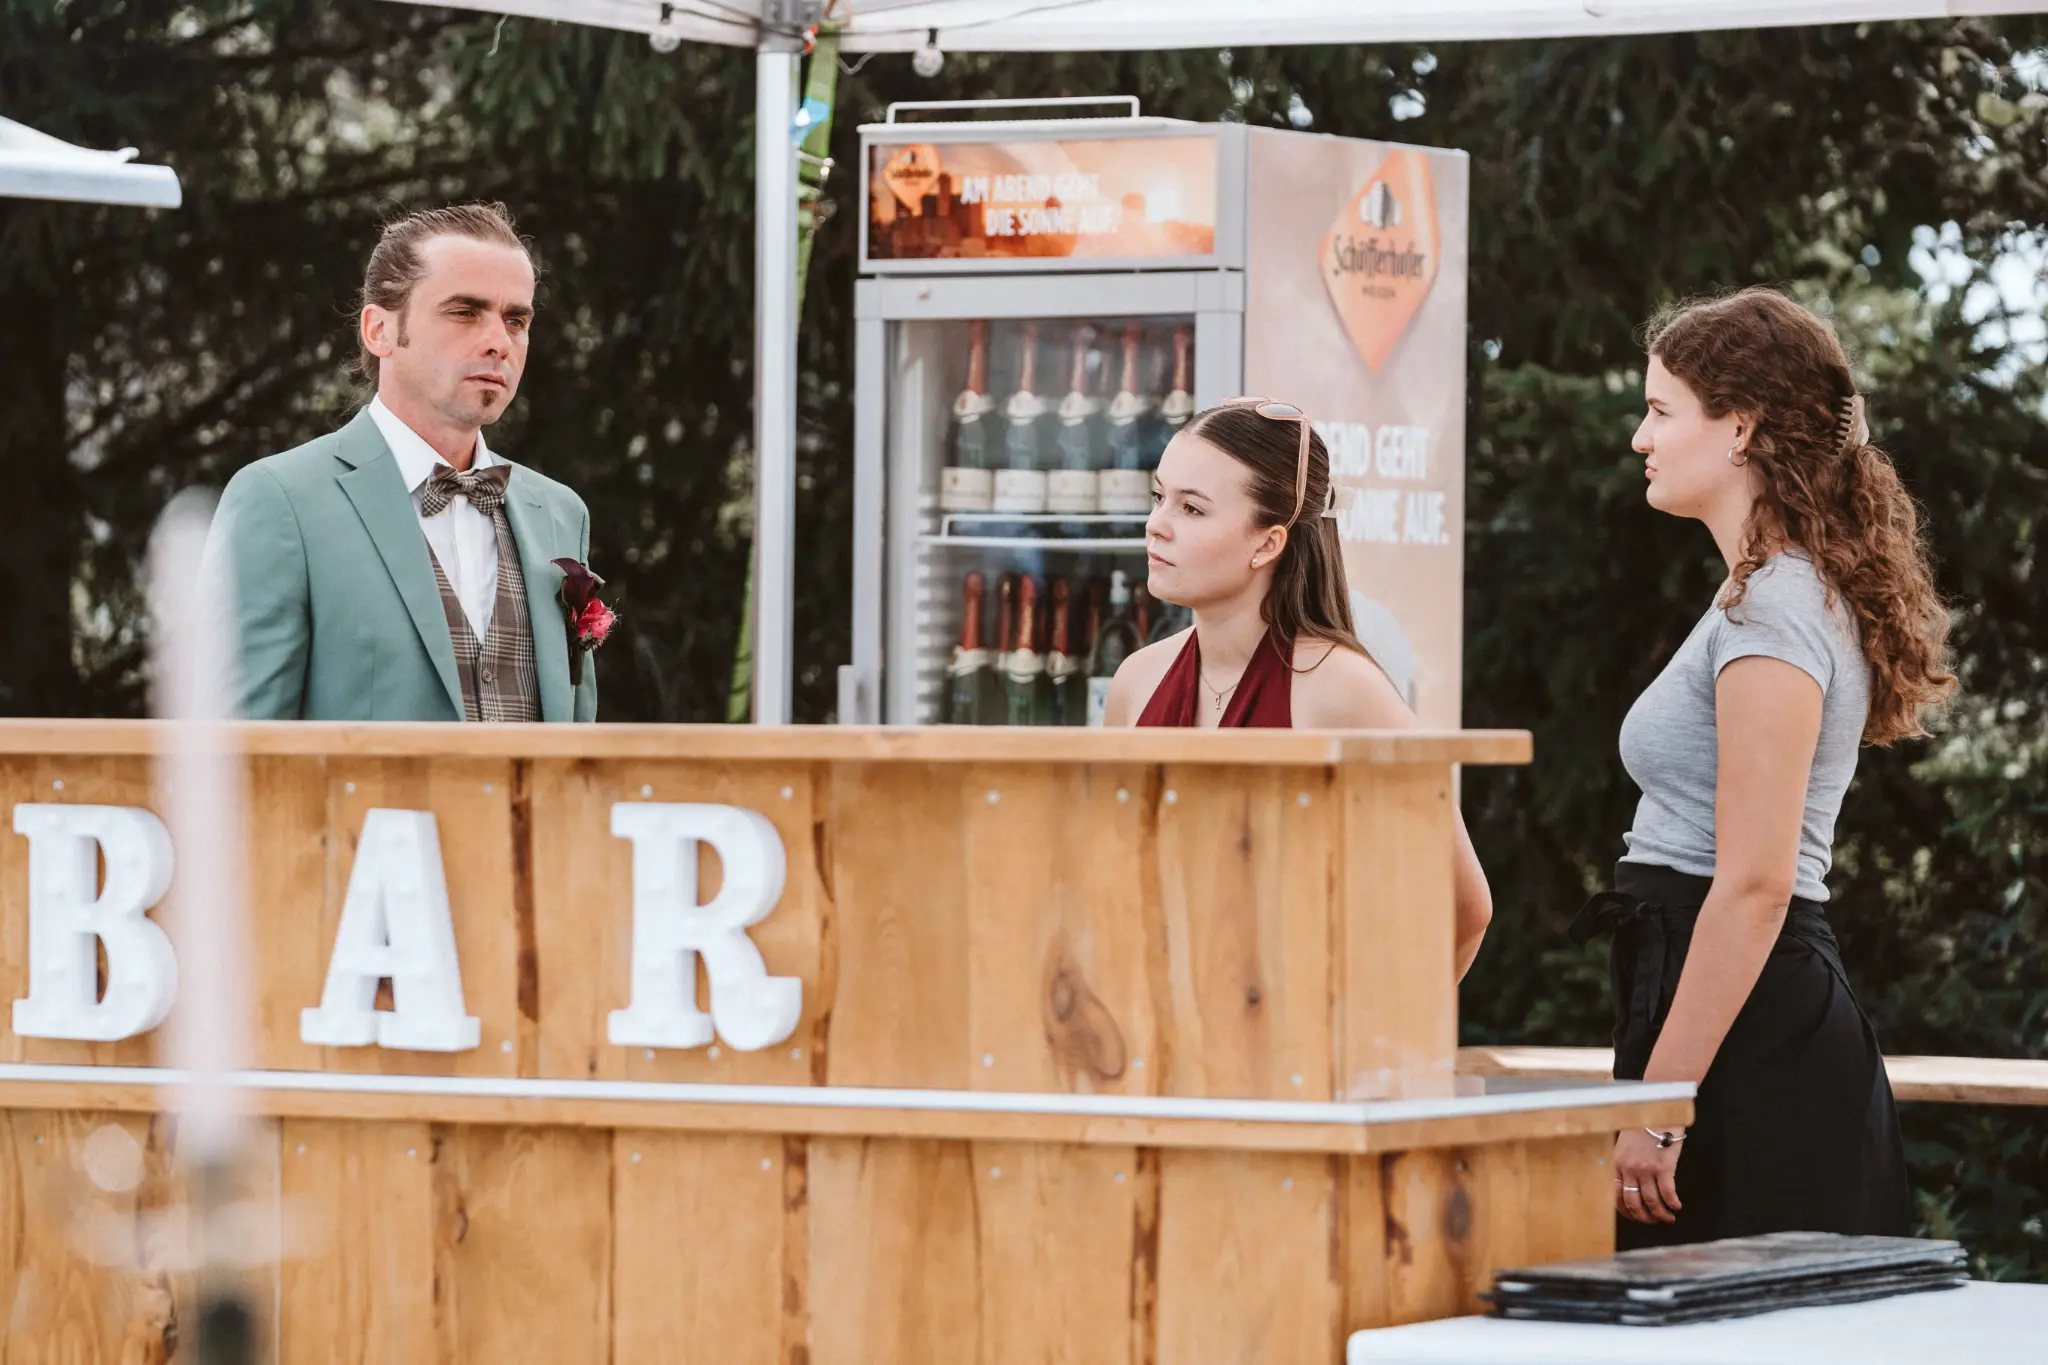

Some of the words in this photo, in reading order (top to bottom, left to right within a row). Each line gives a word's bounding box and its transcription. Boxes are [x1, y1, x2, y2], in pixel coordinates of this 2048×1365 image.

[960, 175, 989, 205] AM
[993, 174, 1051, 203] ABEND
[985, 208, 1017, 238] DIE
[1018, 207, 1076, 237] SONNE
[1375, 424, 1429, 480] GEHT
[12, 802, 802, 1052] BAR
